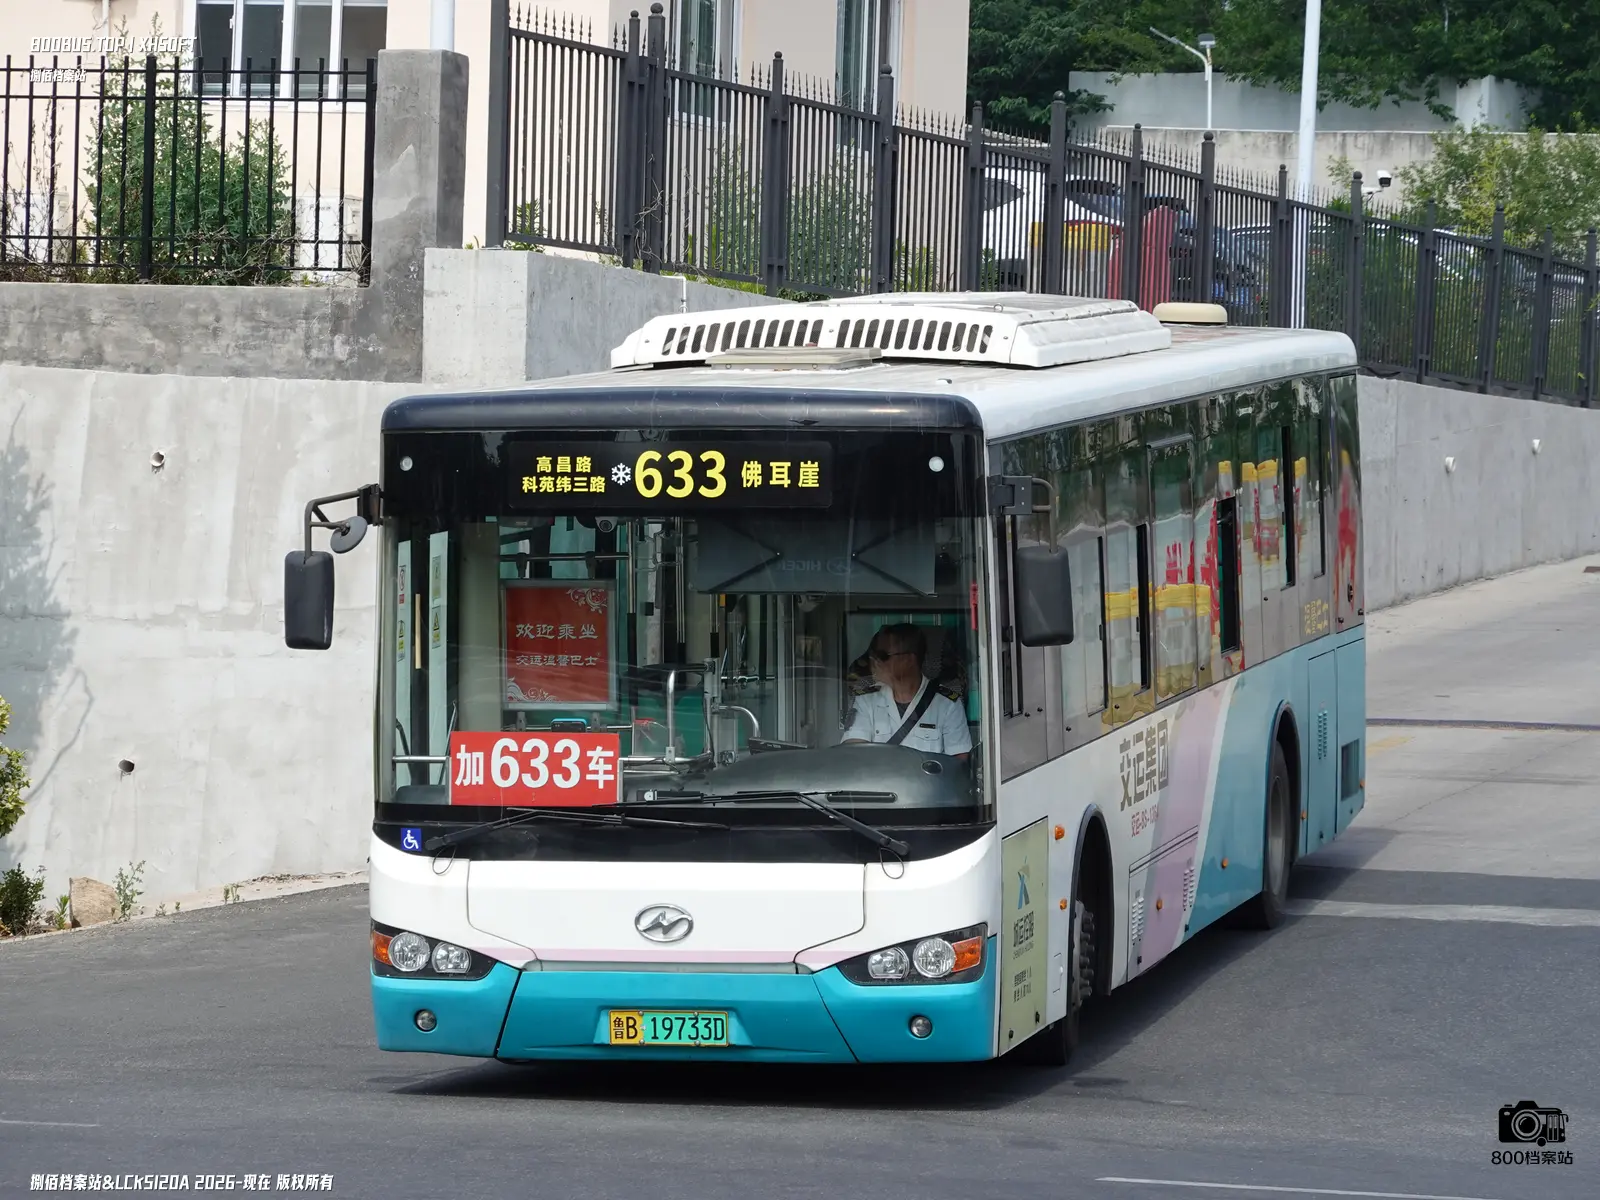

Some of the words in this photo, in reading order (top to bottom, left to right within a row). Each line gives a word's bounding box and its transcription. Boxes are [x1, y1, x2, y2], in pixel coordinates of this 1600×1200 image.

[536, 456, 592, 473] 高昌路
[635, 450, 727, 498] 633
[741, 460, 820, 488] 佛耳崖
[522, 476, 606, 493] 科苑纬三路
[515, 623, 599, 640] 欢迎乘坐
[516, 654, 599, 667] 交运温馨巴士
[1119, 719, 1169, 812] 交运集团
[613, 1016, 638, 1040] 鲁B
[651, 1016, 725, 1041] 19733D
